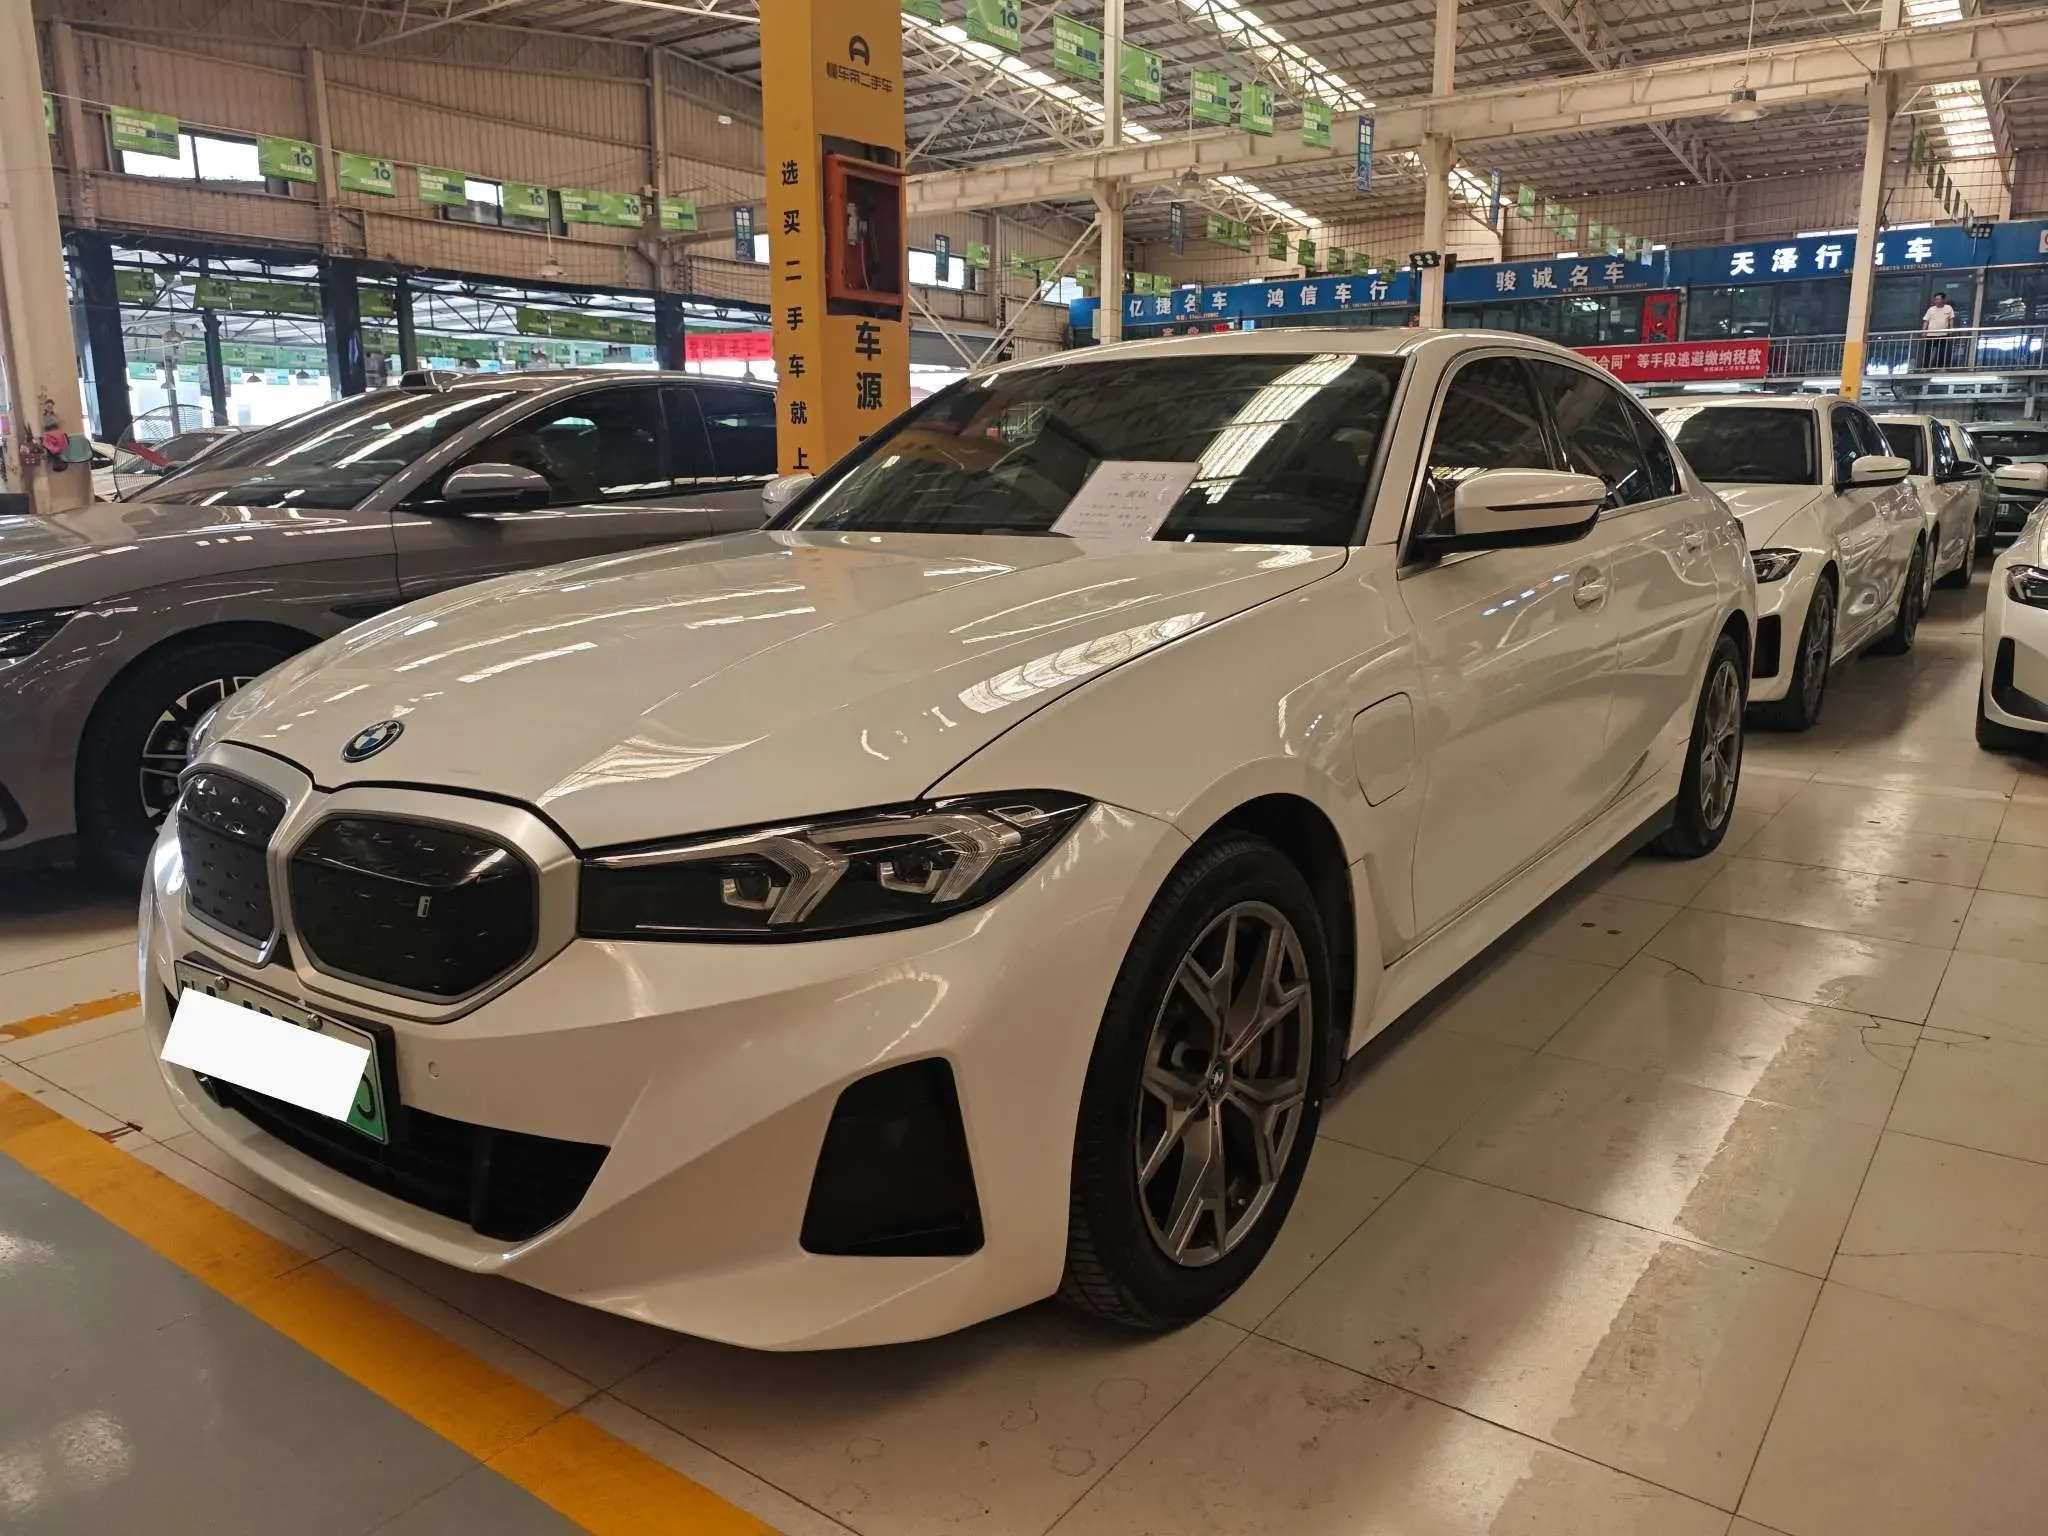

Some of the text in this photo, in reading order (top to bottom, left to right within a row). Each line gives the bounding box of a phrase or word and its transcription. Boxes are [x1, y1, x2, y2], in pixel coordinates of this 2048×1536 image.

[1000, 8, 1018, 29] 10
[294, 151, 312, 167] 10
[372, 167, 391, 181] 10
[1496, 261, 1625, 292] 骏诚名车
[1129, 291, 1228, 318] 亿捷名车
[1267, 280, 1389, 308] 鸿信车行
[781, 159, 809, 471] 选买二手车就上
[855, 320, 883, 442] 车源
